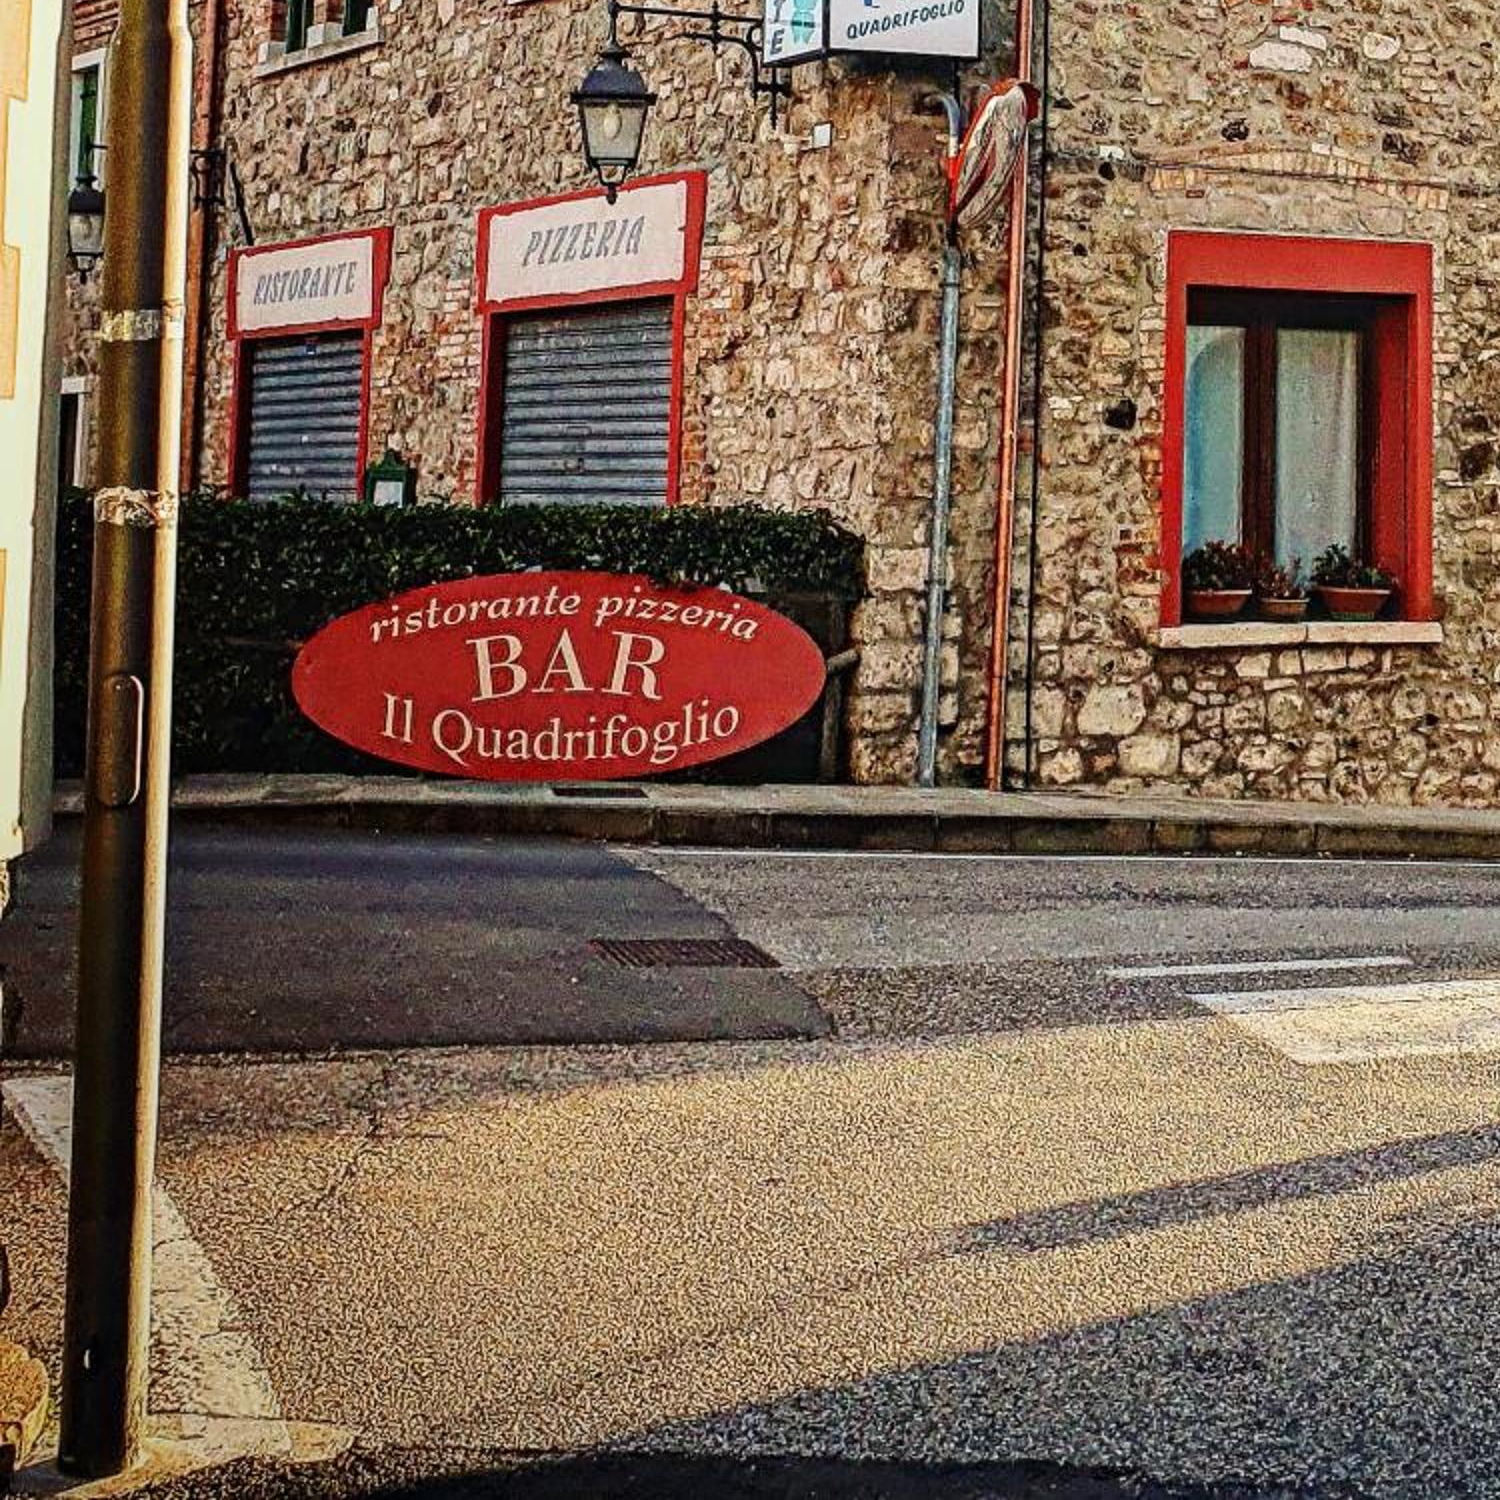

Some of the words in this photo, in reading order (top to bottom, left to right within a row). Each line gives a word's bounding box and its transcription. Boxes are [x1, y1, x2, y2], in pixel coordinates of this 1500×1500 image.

[522, 215, 646, 268] PIZZERIA
[253, 261, 358, 305] RISTORANTE
[370, 586, 581, 642] ristorante
[595, 585, 758, 641] pizzeria
[466, 628, 666, 702] BAR
[382, 692, 413, 743] Il
[431, 700, 741, 767] Quadrifoglio
